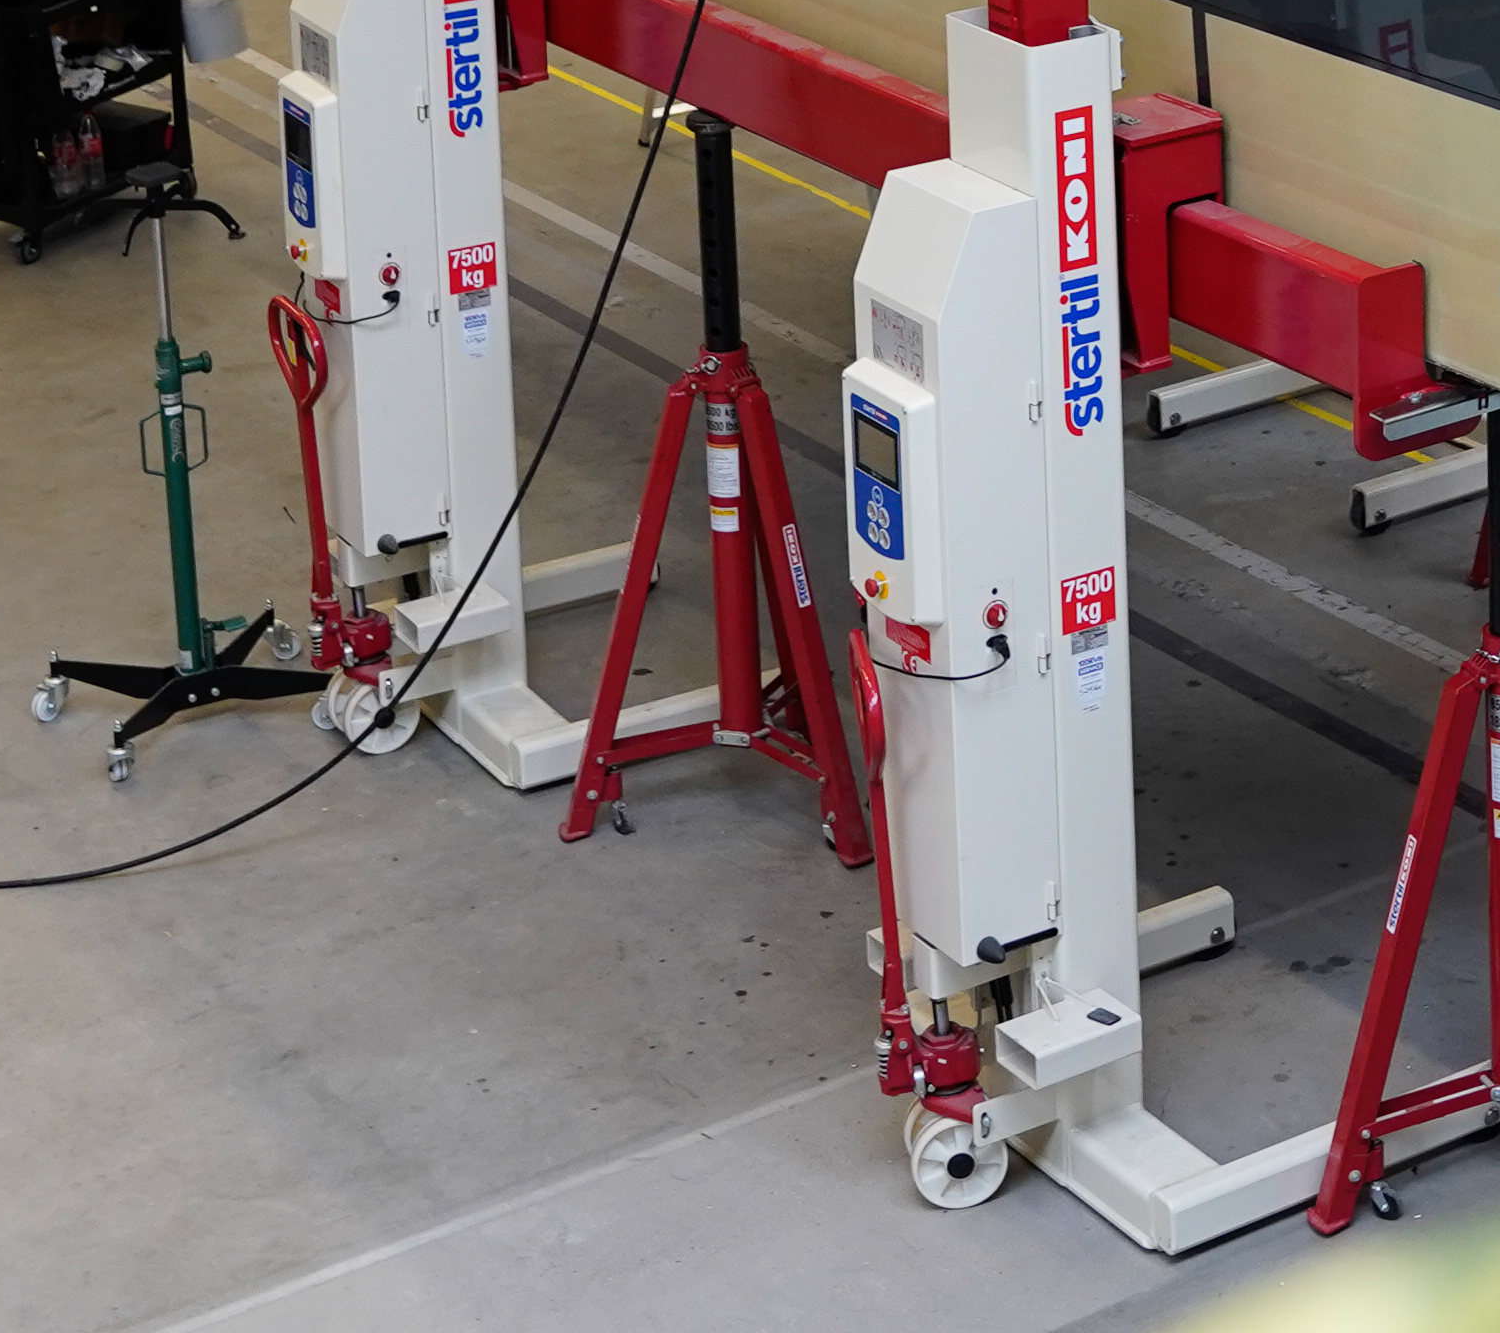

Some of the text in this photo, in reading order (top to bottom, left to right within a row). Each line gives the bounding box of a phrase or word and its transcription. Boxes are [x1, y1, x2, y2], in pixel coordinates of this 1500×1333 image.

[444, 7, 484, 138] stertil
[449, 244, 495, 270] 7500
[461, 269, 485, 289] kg
[1059, 115, 1104, 437] stertil KONI
[1062, 570, 1113, 603] 7500
[1075, 601, 1102, 626] kg
